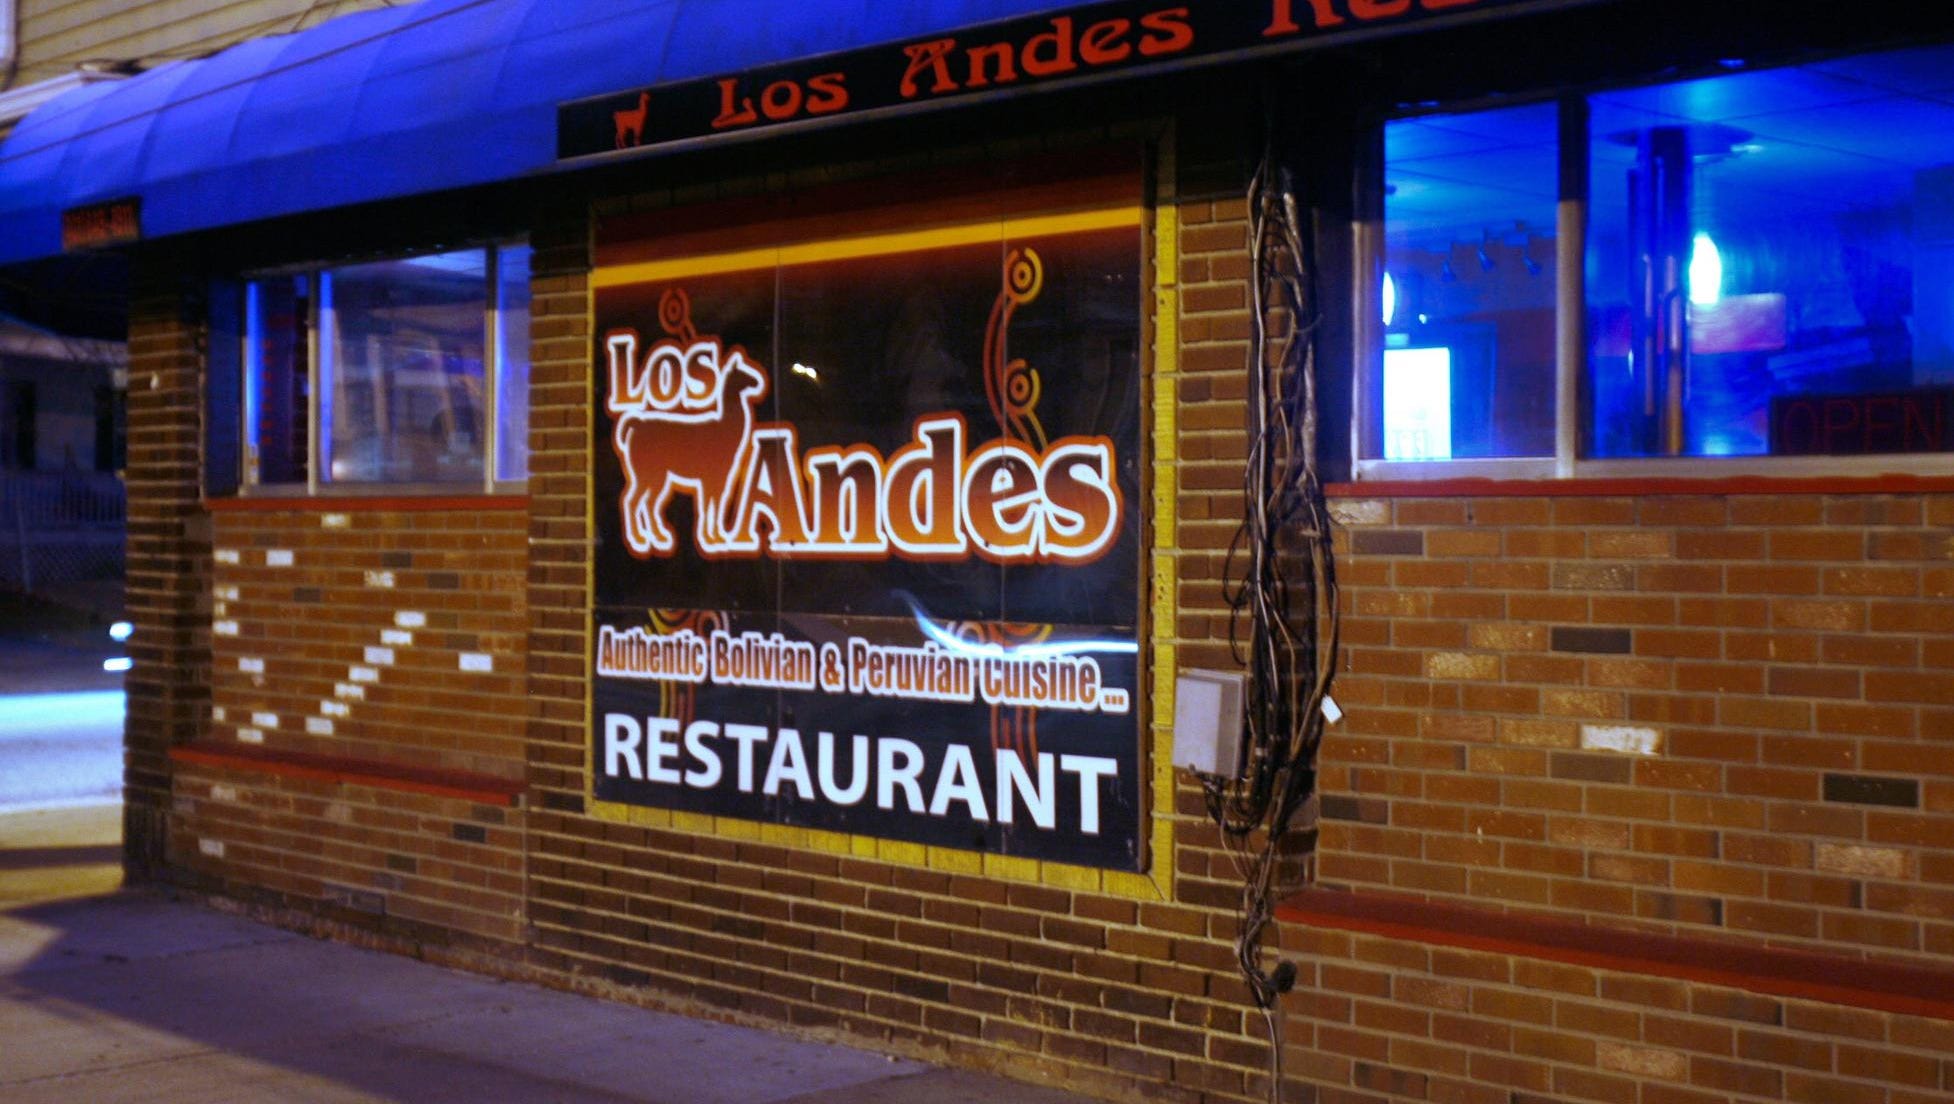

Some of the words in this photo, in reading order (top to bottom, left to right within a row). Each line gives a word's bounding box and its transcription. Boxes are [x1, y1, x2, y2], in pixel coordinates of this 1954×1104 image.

[711, 72, 850, 130] Los
[900, 7, 1194, 97] Andes
[606, 333, 722, 412] Los
[1783, 393, 1944, 455] OPEN
[727, 418, 1118, 557] Andes
[597, 625, 707, 683] Authentic
[711, 630, 817, 690] Bolivian
[820, 642, 845, 692] &
[848, 637, 975, 702] Peruvian
[604, 713, 1118, 834] RESTAURANT
